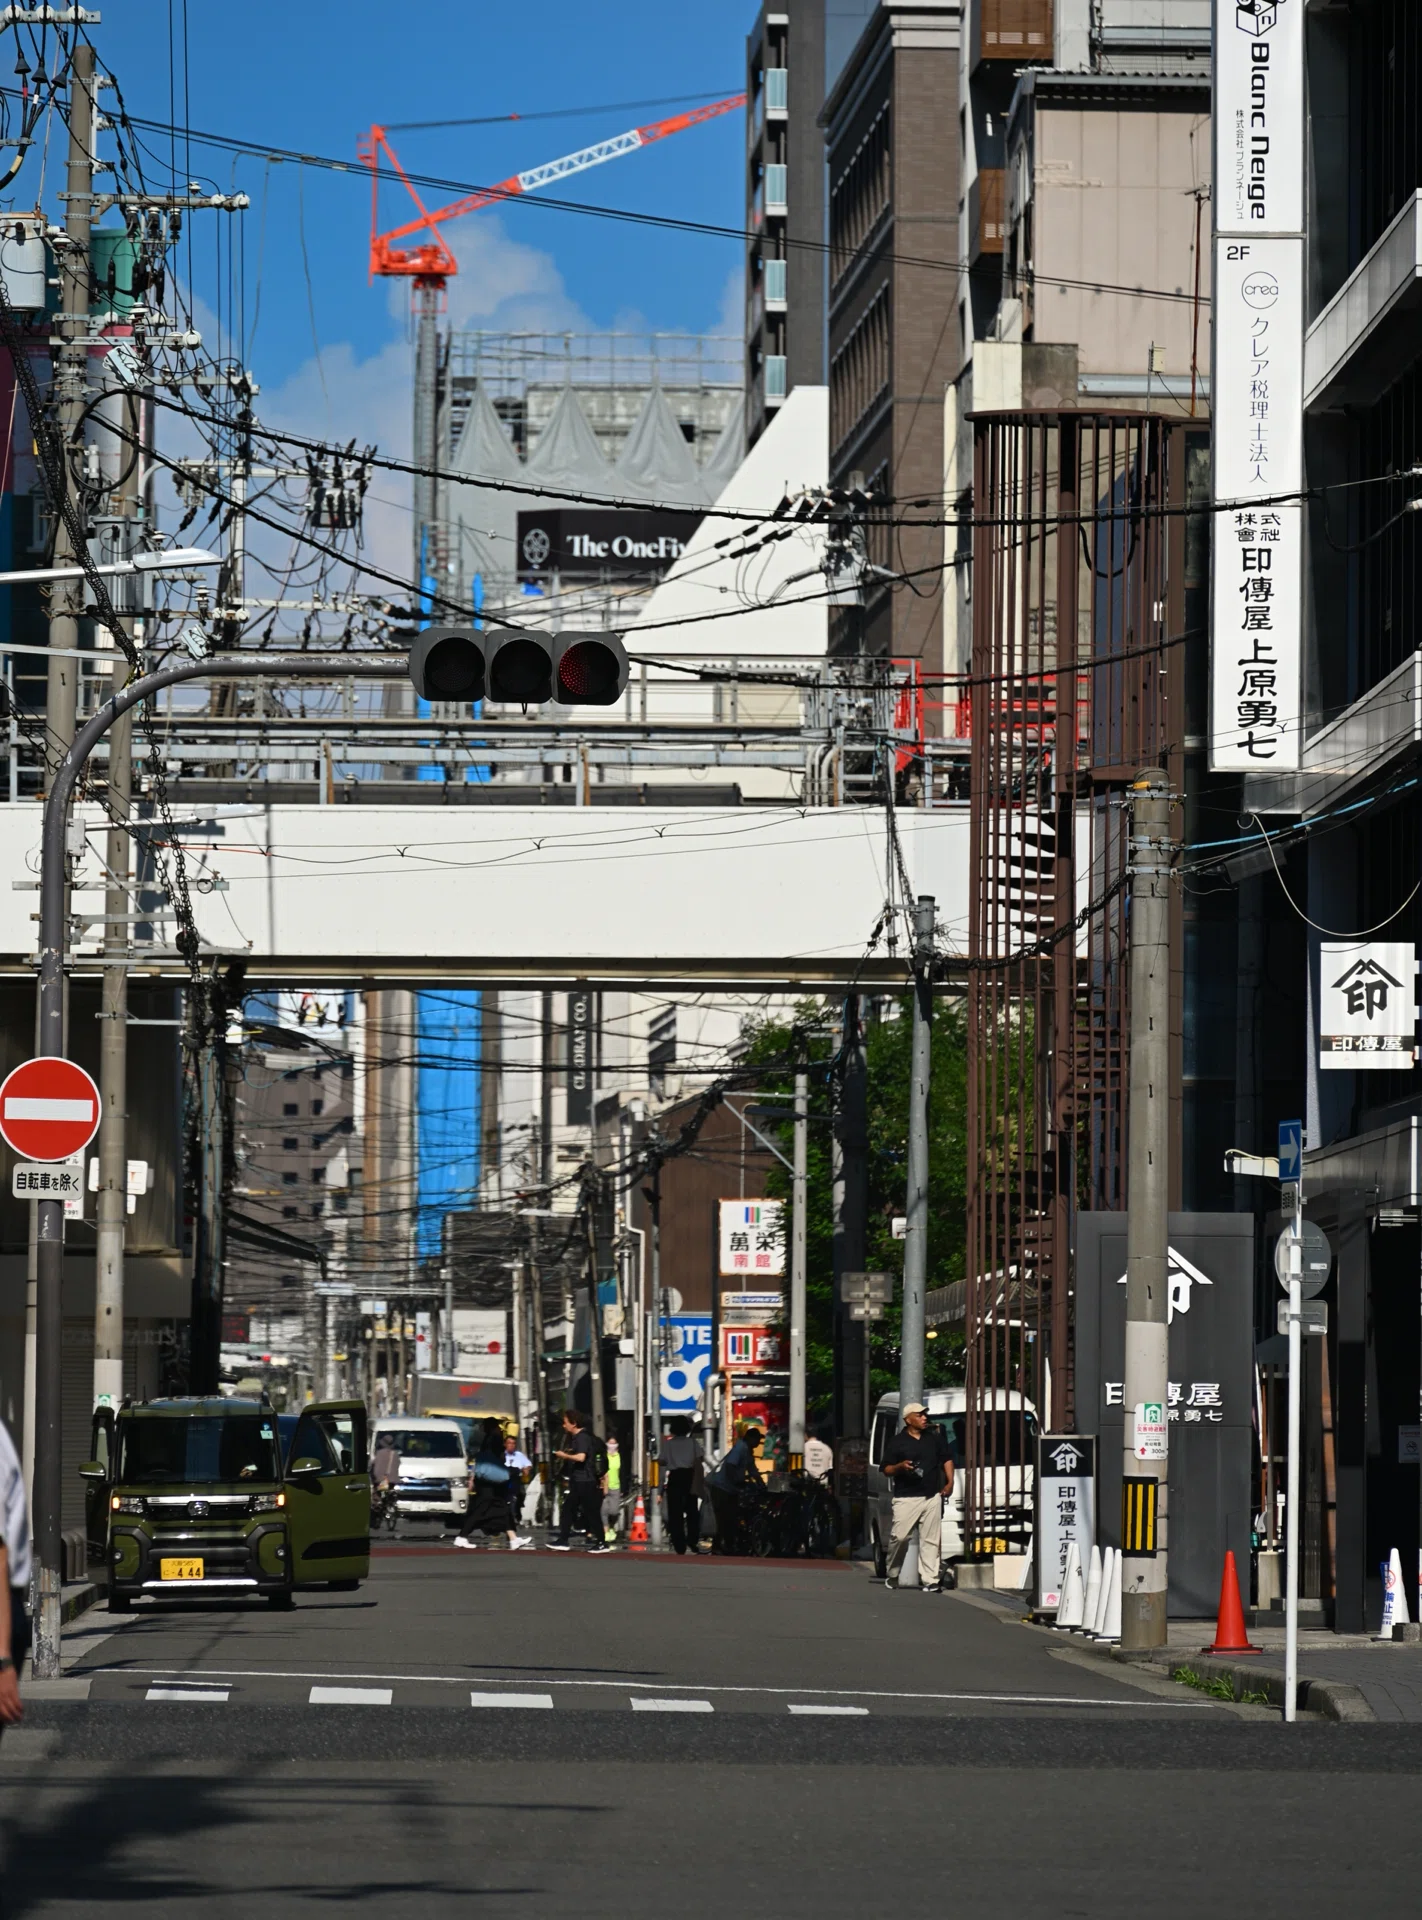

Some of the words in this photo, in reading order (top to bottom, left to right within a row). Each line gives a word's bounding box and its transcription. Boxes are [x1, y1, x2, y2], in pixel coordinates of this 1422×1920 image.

[1251, 42, 1270, 128] Blanc
[1226, 245, 1251, 260] 2F
[1249, 316, 1270, 484] クレア税理士法人
[566, 534, 609, 558] The
[1331, 1035, 1404, 1052] 印傳屋
[16, 1171, 80, 1192] 自転車を除く
[733, 1253, 772, 1268] 南館
